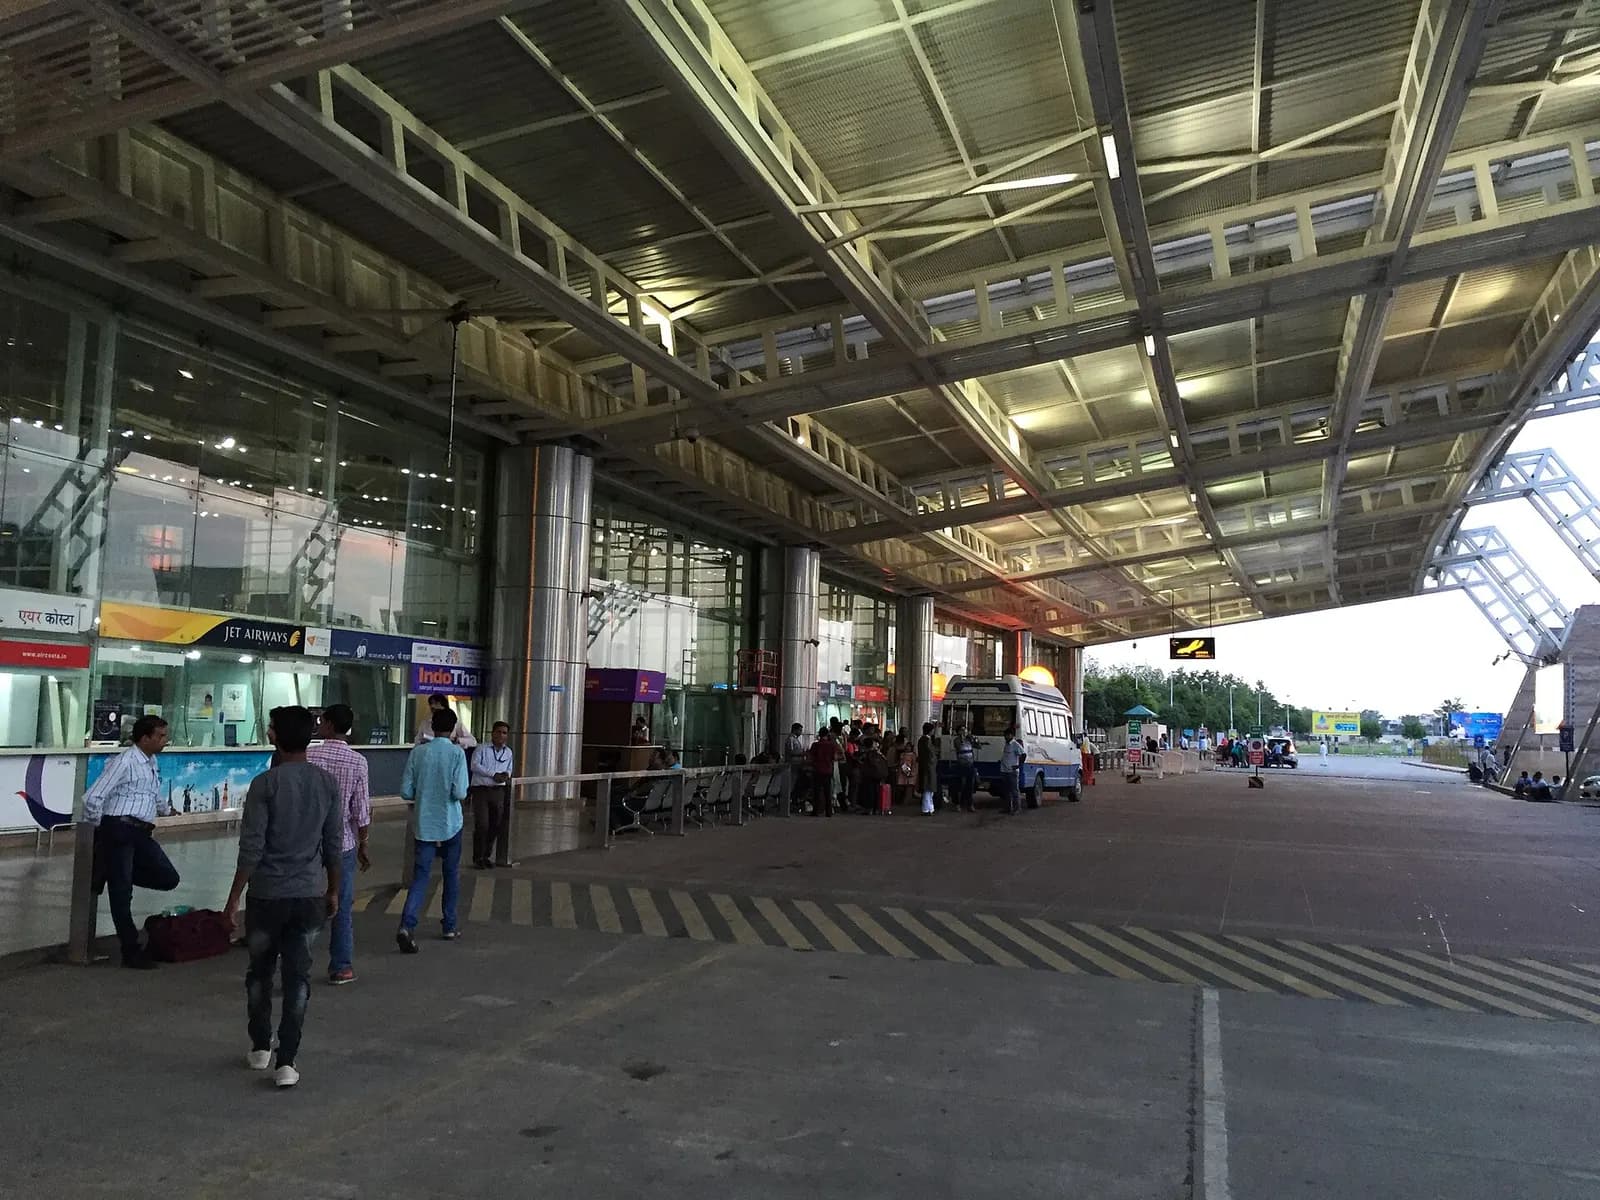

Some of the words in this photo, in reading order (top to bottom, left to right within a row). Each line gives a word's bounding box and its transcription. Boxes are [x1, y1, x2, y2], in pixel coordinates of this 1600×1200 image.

[18, 610, 43, 625] एयर
[45, 608, 74, 626] कोस्टा
[224, 626, 242, 642] JET
[244, 628, 288, 644] AIRWAYS
[418, 666, 481, 687] IndoThai
